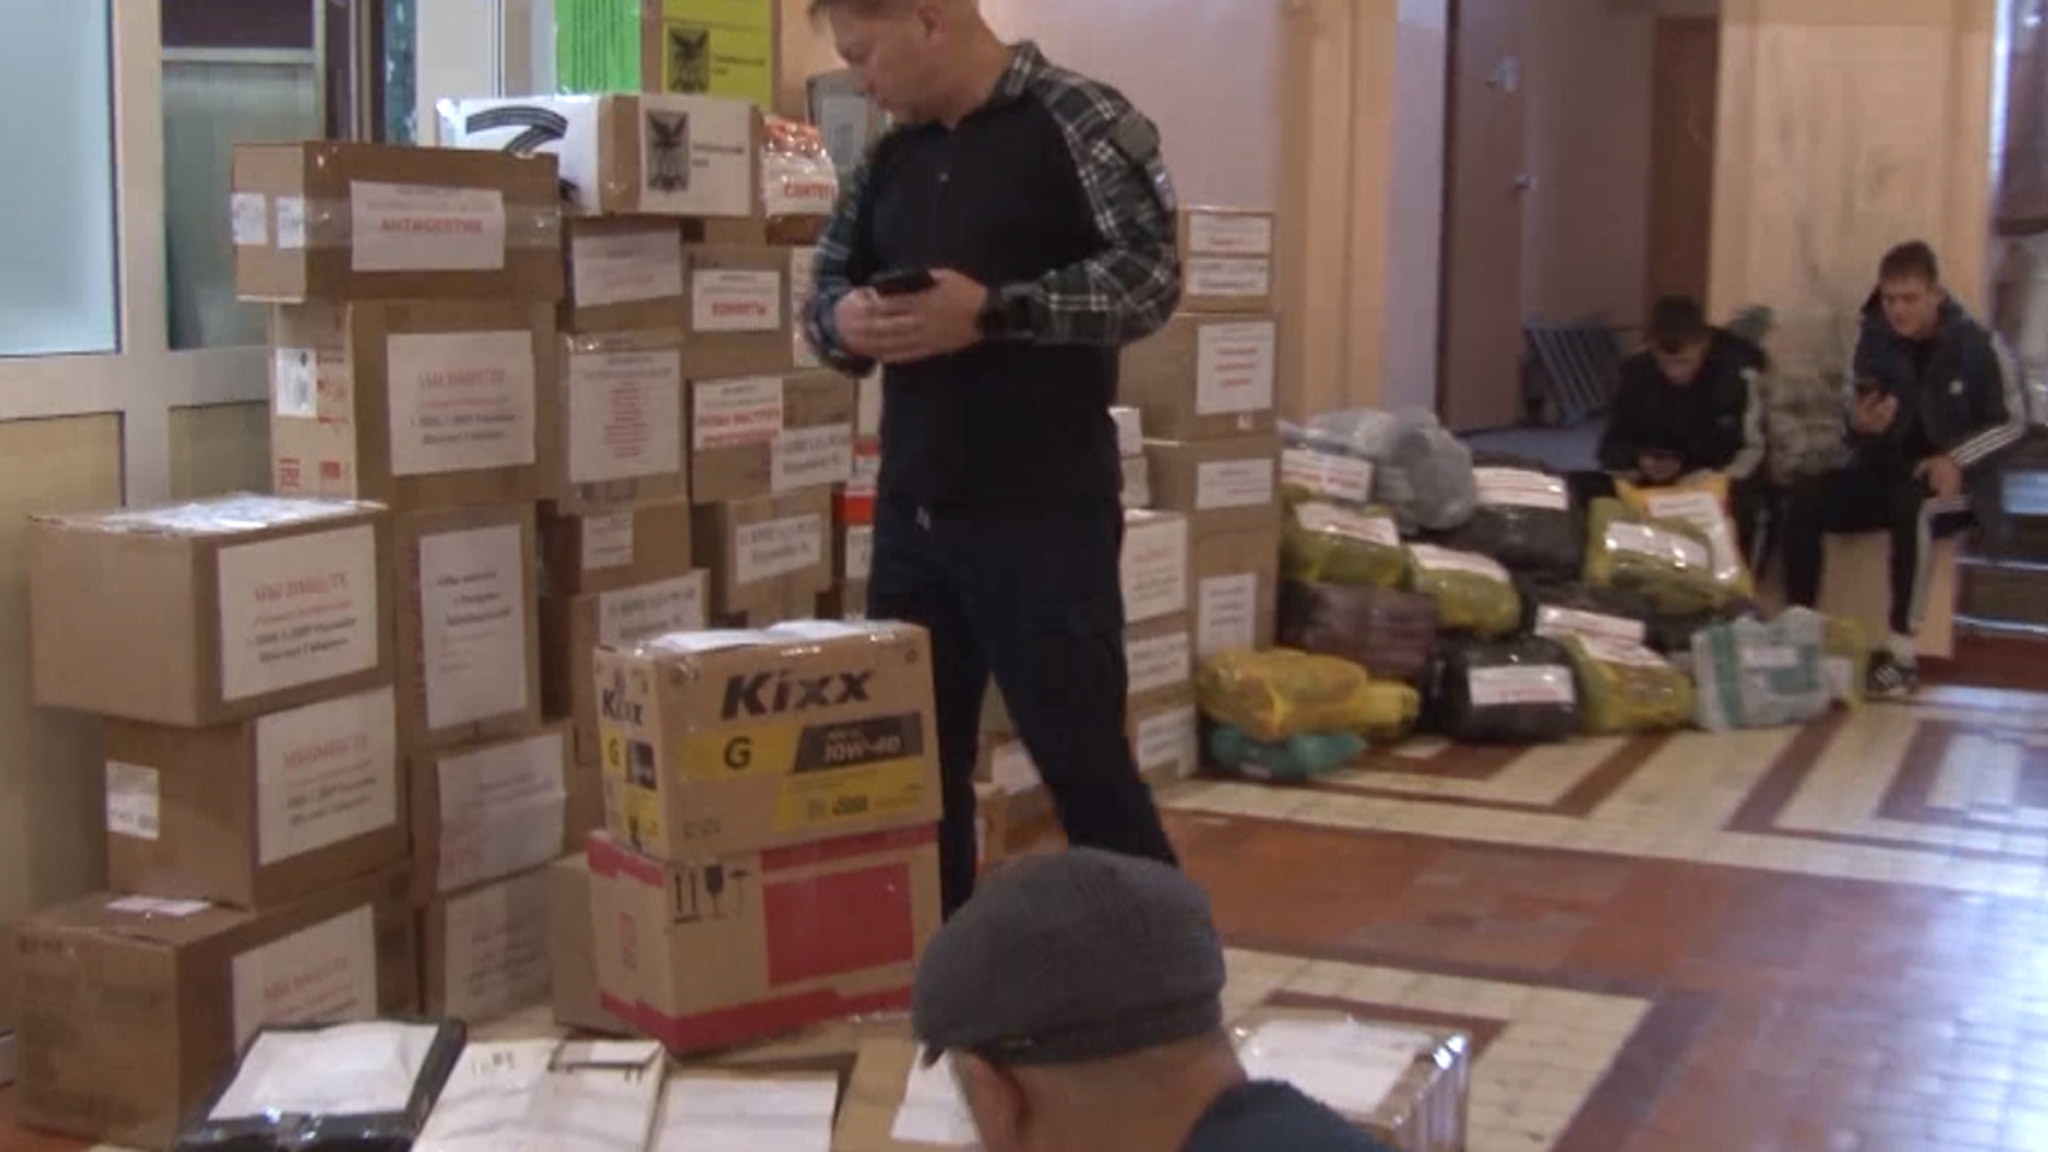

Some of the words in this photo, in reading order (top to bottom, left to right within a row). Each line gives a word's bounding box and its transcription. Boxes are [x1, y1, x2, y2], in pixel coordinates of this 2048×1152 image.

[721, 668, 876, 720] Kixx
[608, 738, 621, 766] G
[724, 736, 753, 770] G
